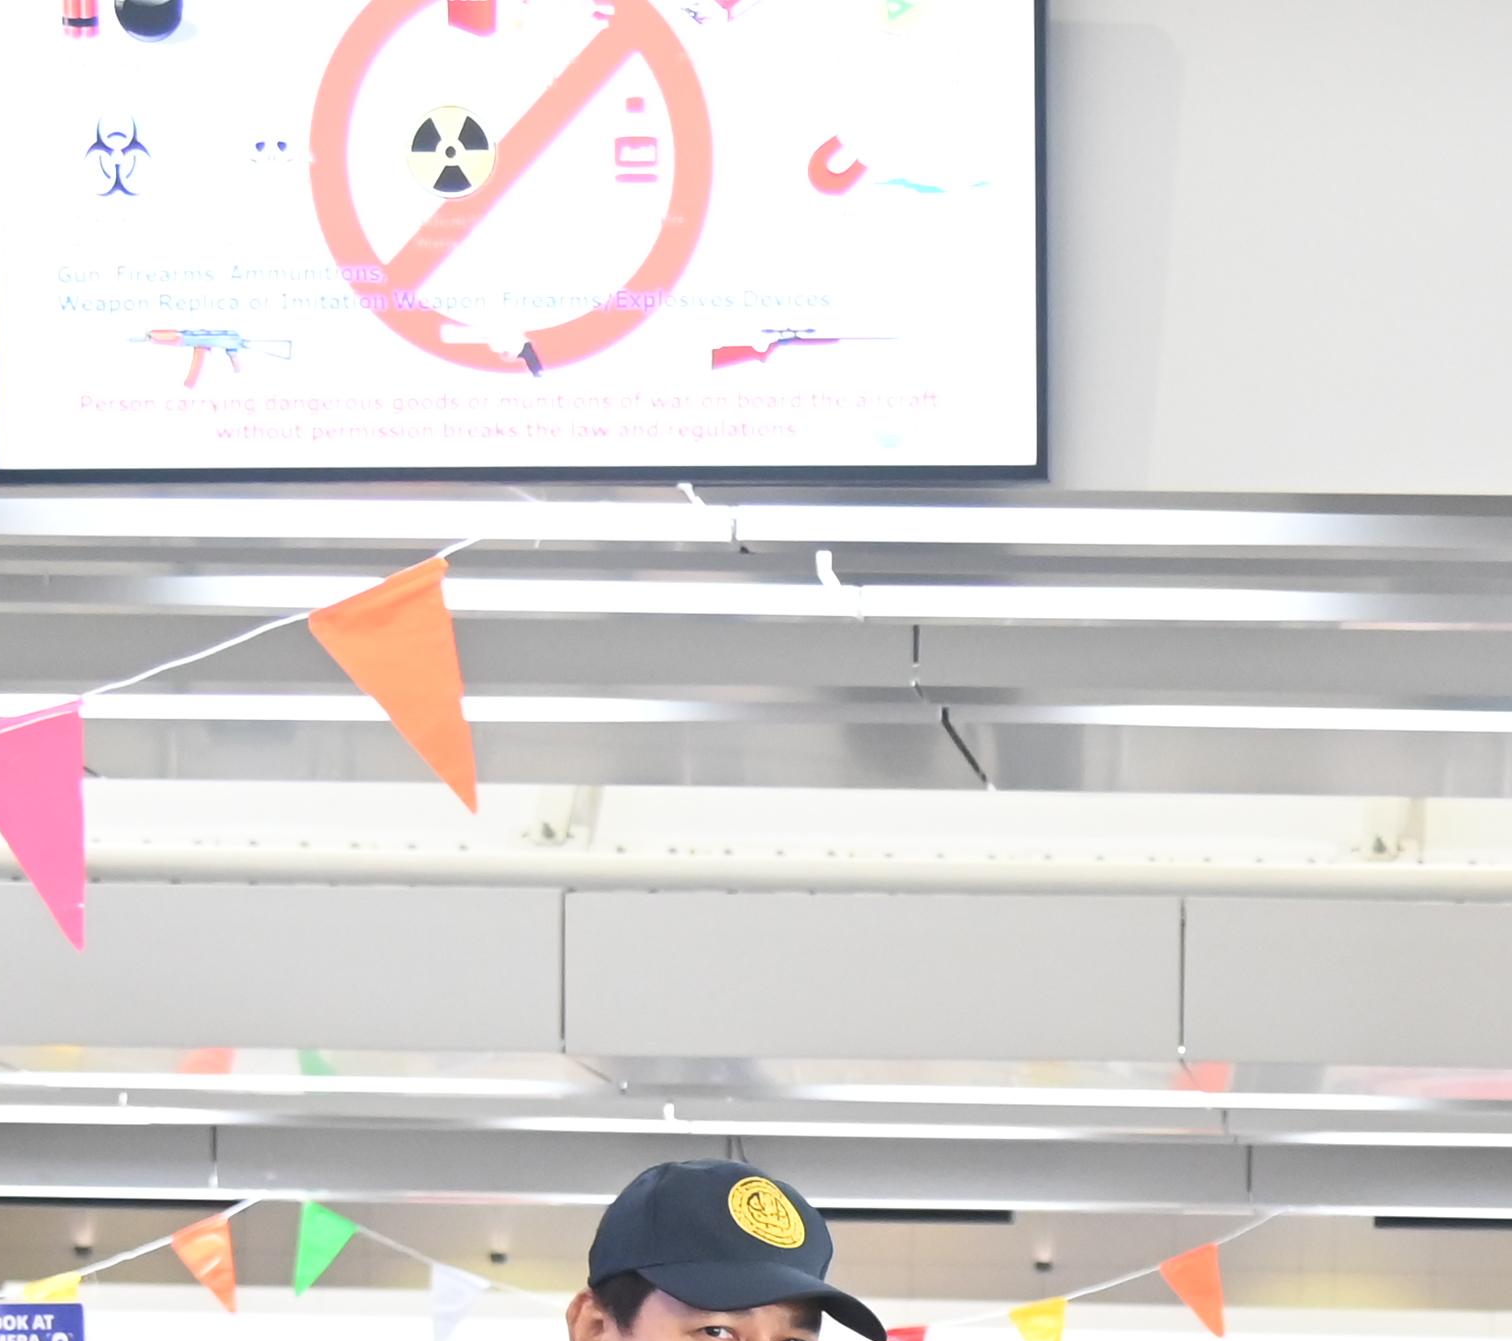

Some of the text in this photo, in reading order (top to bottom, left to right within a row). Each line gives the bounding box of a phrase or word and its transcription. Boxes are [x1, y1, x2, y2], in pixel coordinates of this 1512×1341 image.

[58, 294, 148, 314] Weapon
[158, 294, 239, 313] Replica
[280, 293, 387, 311] Imitation
[743, 290, 830, 307] Devices
[80, 395, 155, 412] Person
[164, 395, 255, 415] carrying
[265, 394, 383, 414] dangerous
[392, 394, 459, 414] goods
[500, 393, 611, 409] munitions
[620, 391, 641, 408] of
[650, 394, 691, 409] war
[701, 394, 728, 409] on
[737, 391, 802, 409] board
[811, 391, 846, 408] the
[216, 423, 302, 440] without
[312, 423, 433, 442] permission
[442, 422, 517, 439] breaks
[526, 421, 561, 438] the
[570, 421, 608, 438] law
[618, 421, 659, 438] and
[32, 1314, 55, 1331] AT
